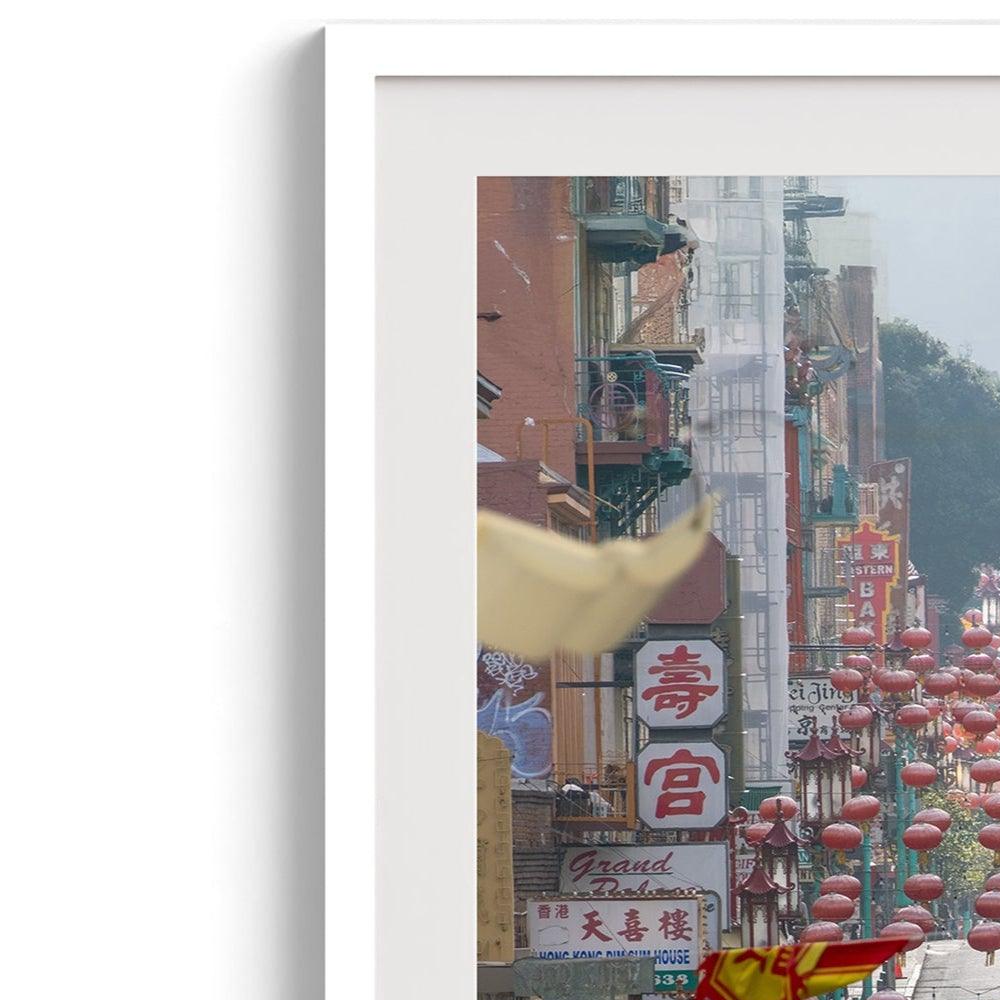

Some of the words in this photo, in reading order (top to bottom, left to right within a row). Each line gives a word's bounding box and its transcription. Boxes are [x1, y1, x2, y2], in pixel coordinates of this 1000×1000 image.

[841, 565, 893, 575] STERN
[789, 682, 805, 700] ei
[569, 850, 673, 882] Grand
[537, 904, 569, 919] 香港
[581, 909, 693, 942] 天喜樓
[655, 950, 690, 964] HOUSE
